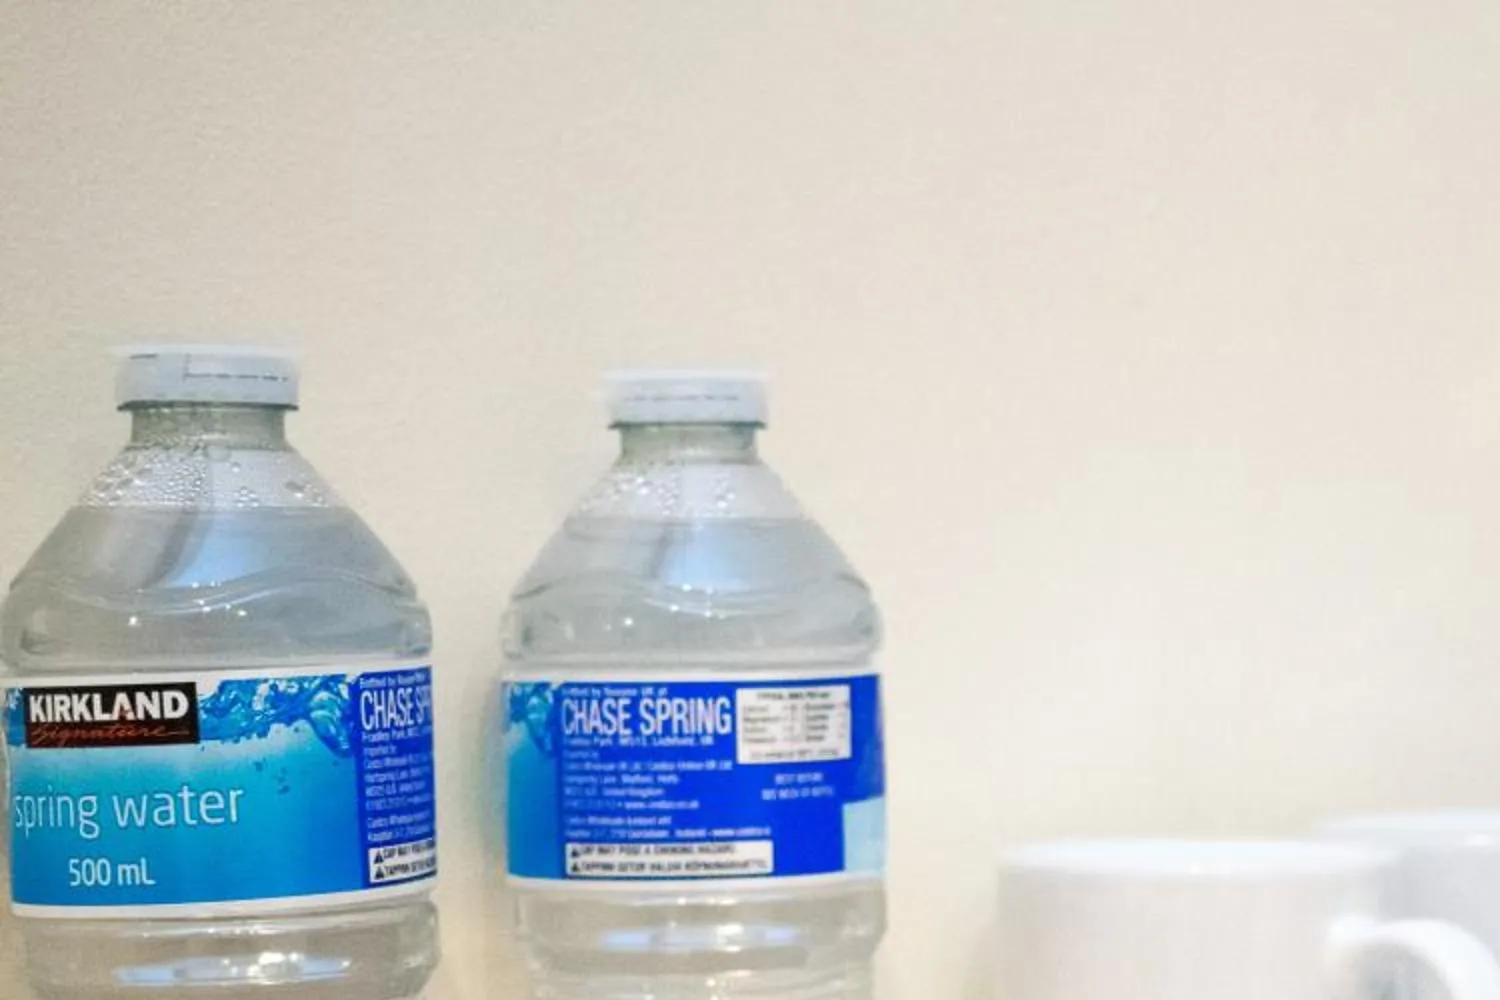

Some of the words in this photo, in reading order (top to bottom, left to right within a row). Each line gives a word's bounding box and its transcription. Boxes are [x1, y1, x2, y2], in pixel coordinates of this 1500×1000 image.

[28, 689, 190, 723] KIRKLAND
[361, 686, 415, 730] CHASE
[562, 697, 633, 735] CHASE
[638, 696, 733, 736] SPRING
[31, 723, 190, 747] Signature
[15, 784, 101, 839] spring
[112, 785, 245, 829] water
[68, 857, 112, 887] 500
[116, 856, 157, 887] mL
